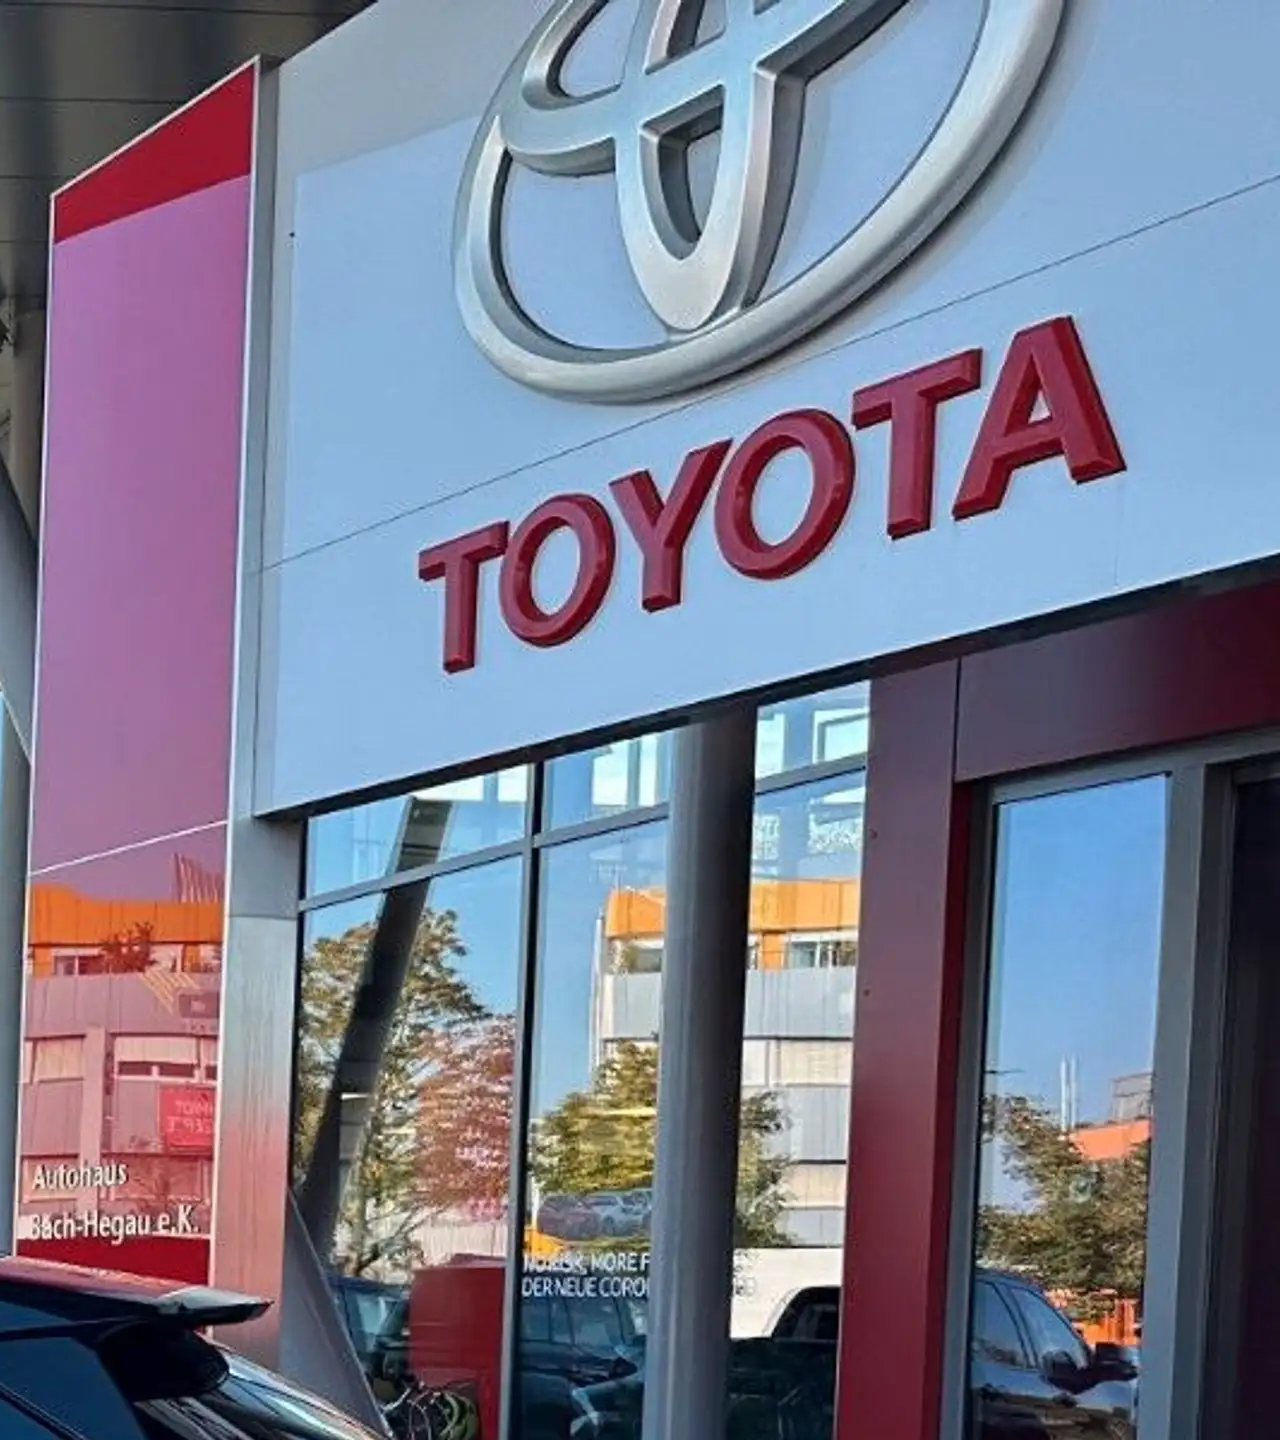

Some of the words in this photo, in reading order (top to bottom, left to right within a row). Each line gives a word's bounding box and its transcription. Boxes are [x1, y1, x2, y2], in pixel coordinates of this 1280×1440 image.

[418, 315, 1127, 675] TOYOTA
[32, 1162, 129, 1191] Autohaus
[157, 1204, 200, 1236] e.K.
[591, 1252, 638, 1271] MORE
[522, 1277, 553, 1298] DER
[555, 1277, 598, 1298] NEUE
